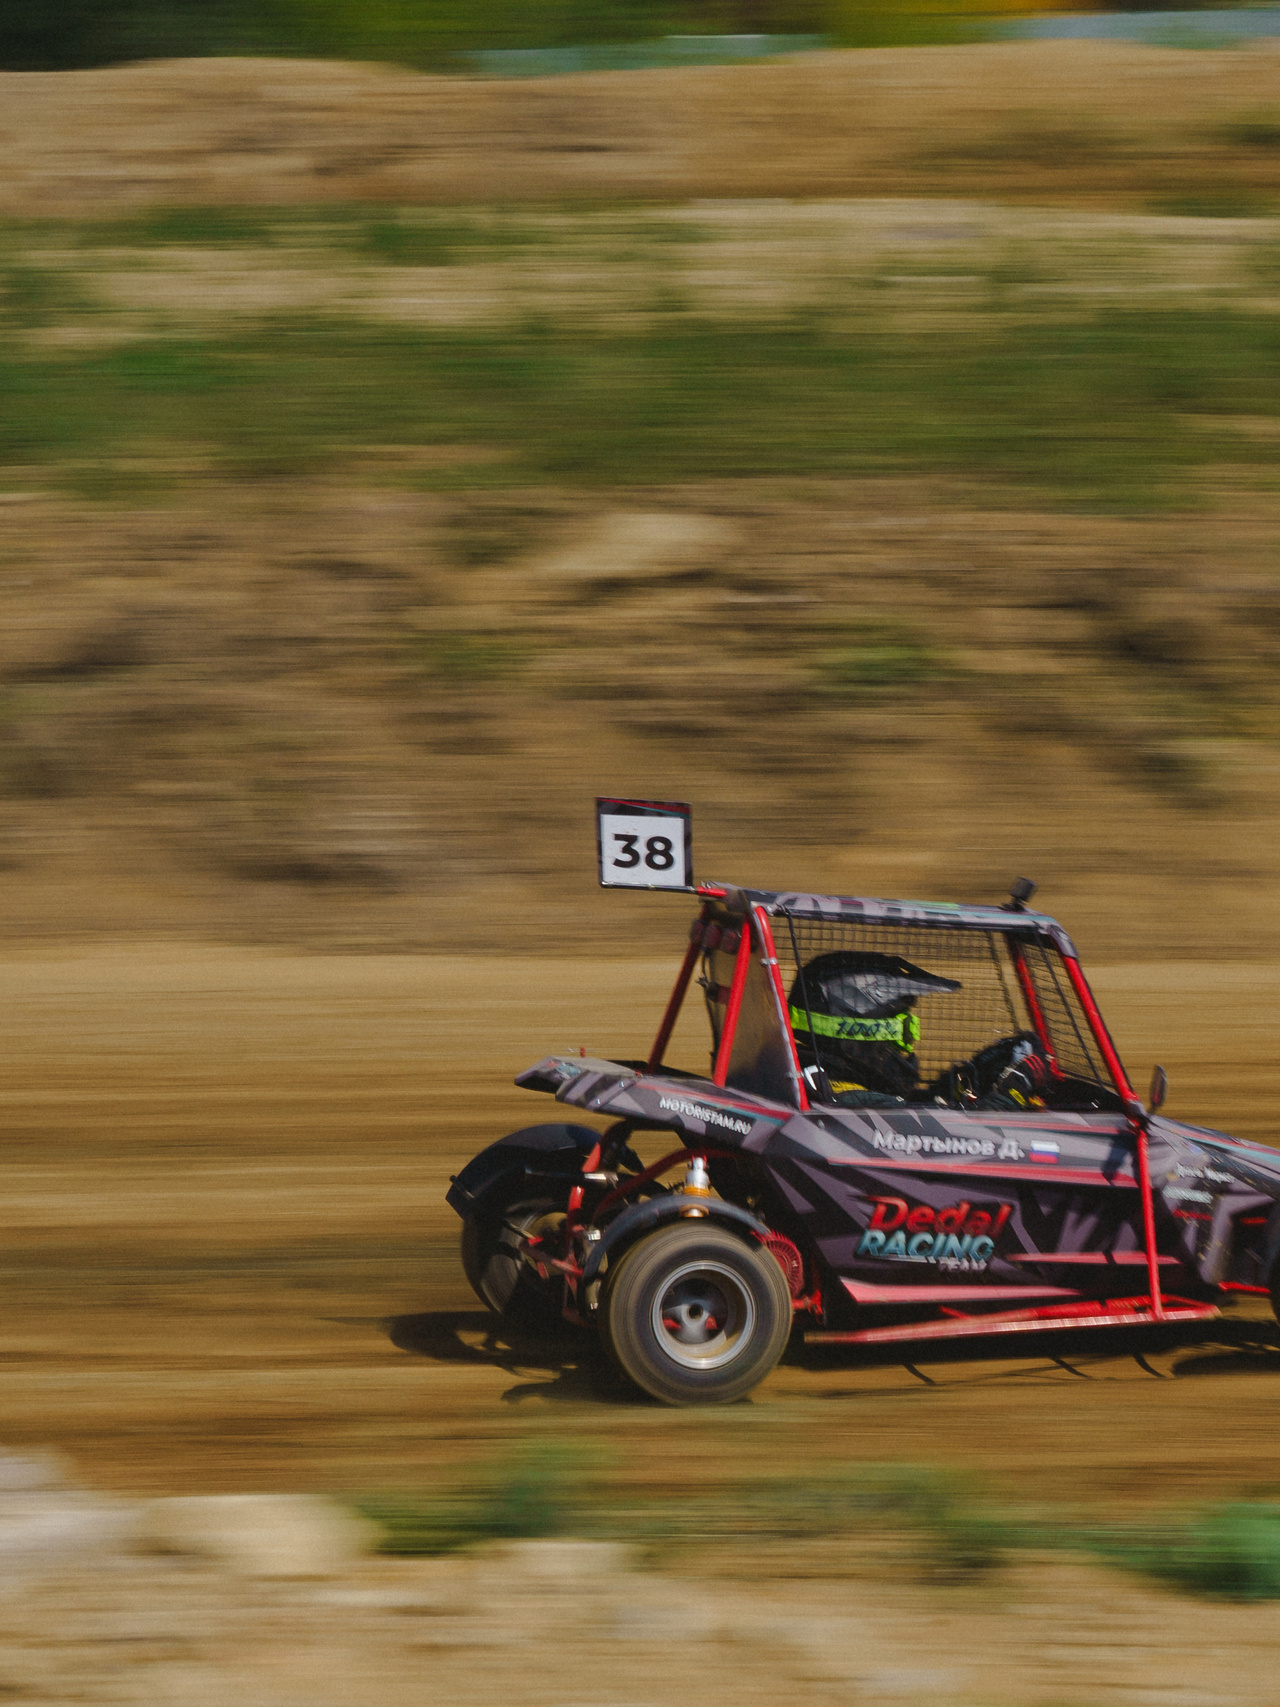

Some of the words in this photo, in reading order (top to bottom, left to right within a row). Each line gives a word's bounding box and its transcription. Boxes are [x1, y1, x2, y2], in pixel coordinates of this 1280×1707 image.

[612, 833, 674, 871] 38
[659, 1096, 752, 1135] MOTORISTAM.RU
[872, 1129, 996, 1155] Мартынов
[998, 1138, 1026, 1161] Д.
[866, 1195, 1013, 1238] Dedal
[856, 1229, 995, 1263] RACING
